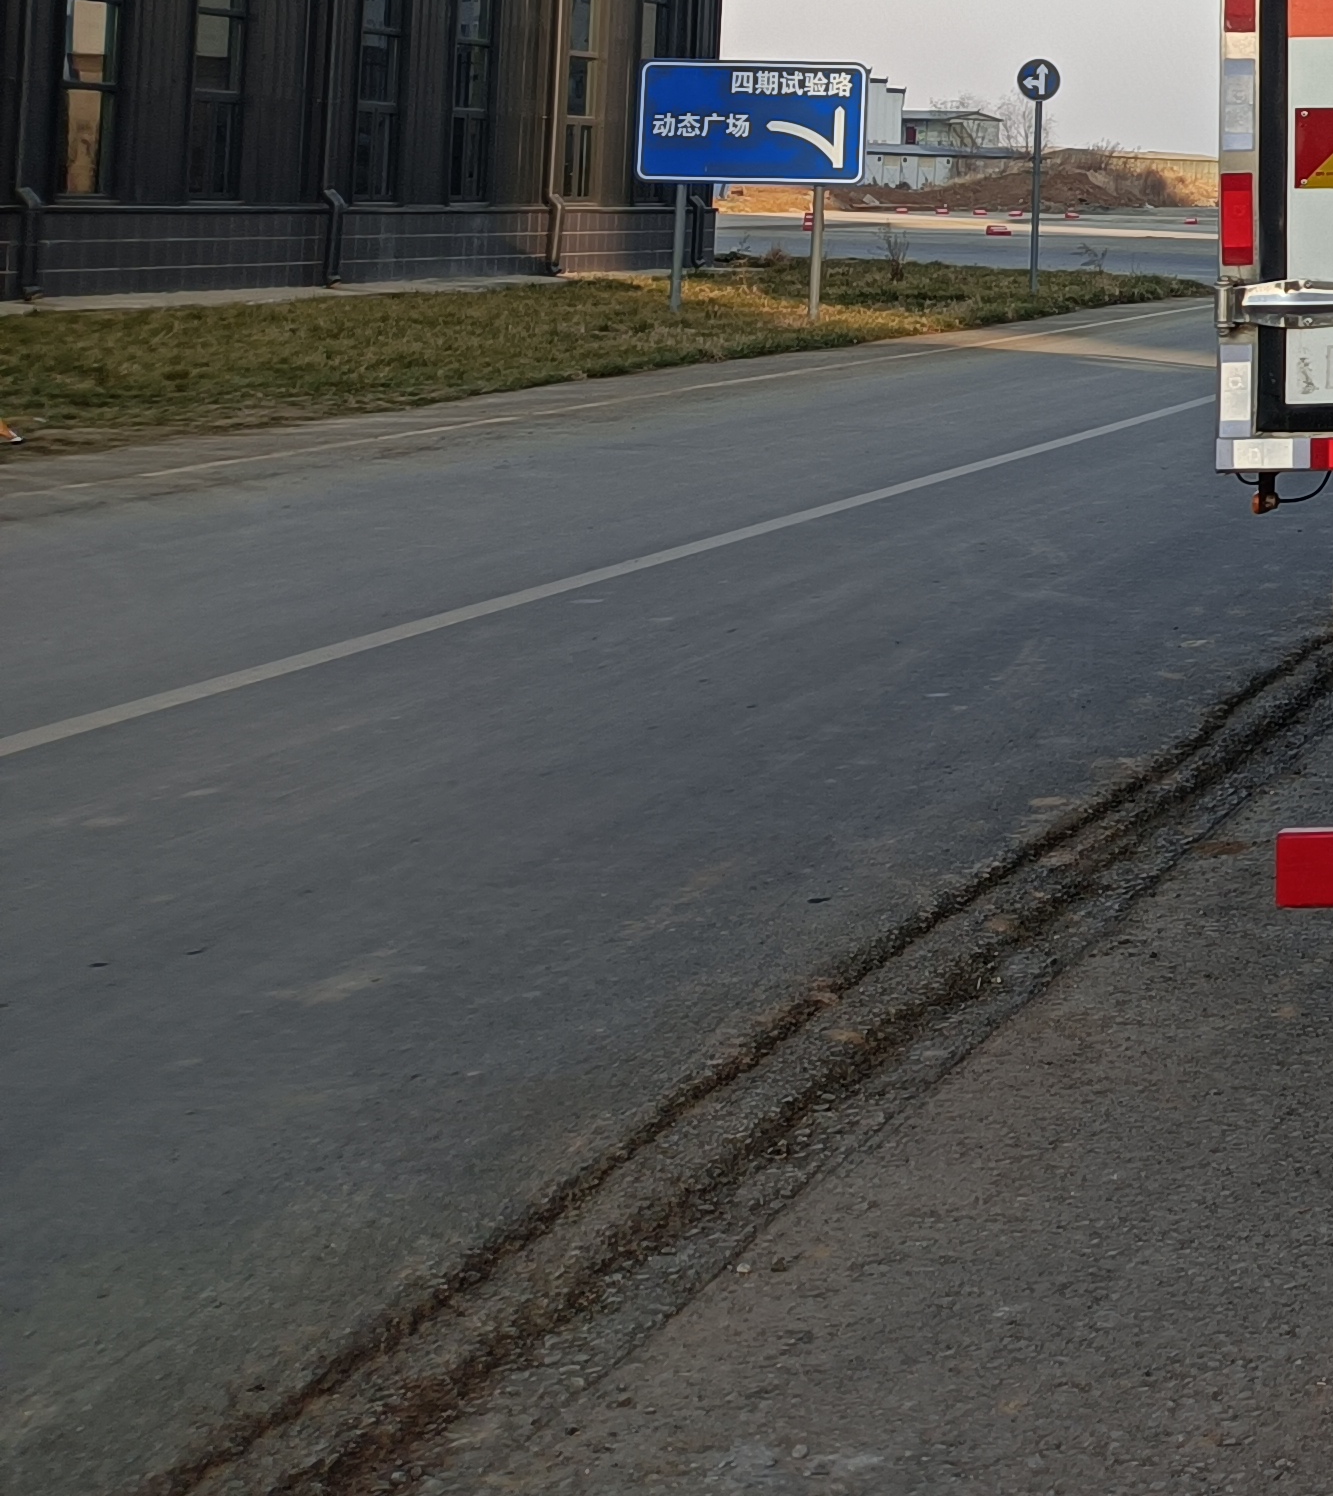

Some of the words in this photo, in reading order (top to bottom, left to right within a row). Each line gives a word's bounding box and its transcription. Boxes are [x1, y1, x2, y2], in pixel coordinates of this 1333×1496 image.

[731, 70, 852, 98] 四期试验路
[652, 112, 750, 138] 动态广场
